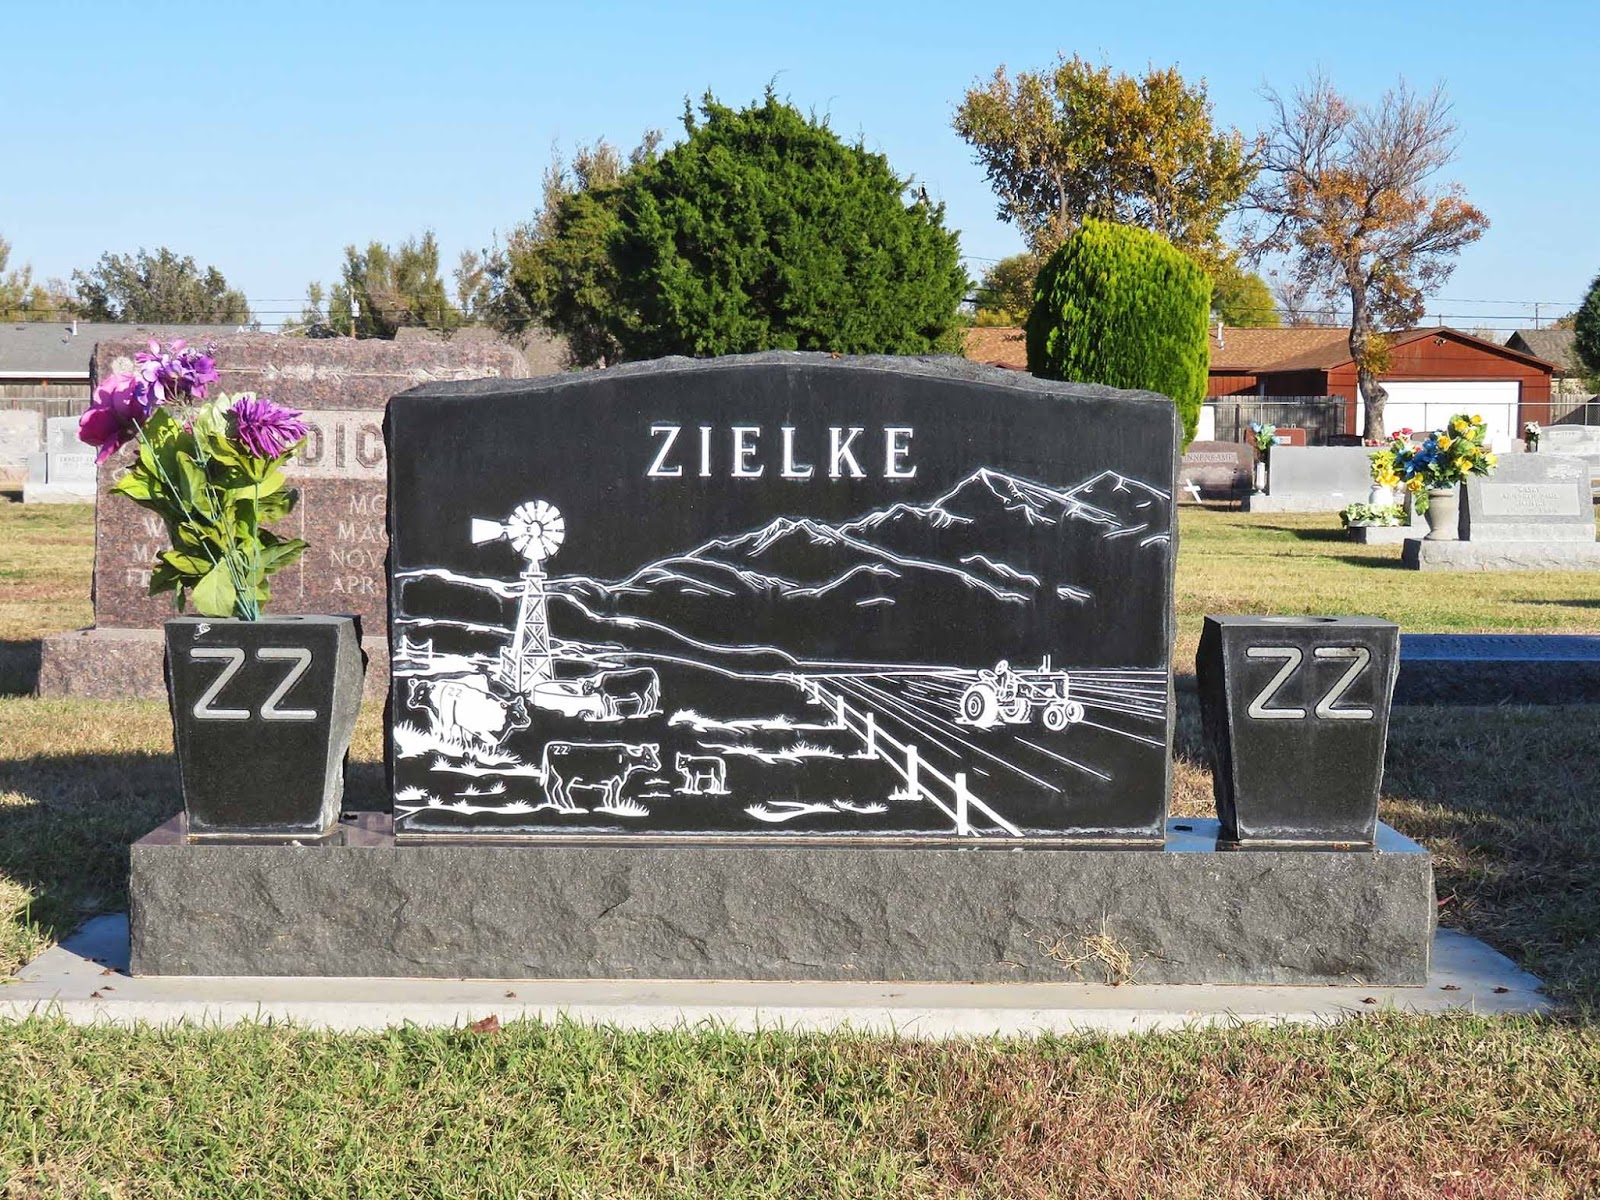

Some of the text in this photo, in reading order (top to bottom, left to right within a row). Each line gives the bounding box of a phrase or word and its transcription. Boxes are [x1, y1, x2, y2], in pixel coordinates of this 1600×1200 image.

[297, 422, 385, 468] DIC
[646, 425, 918, 479] ZIELKE
[190, 647, 318, 720] ZZ
[1246, 647, 1374, 719] ZZ
